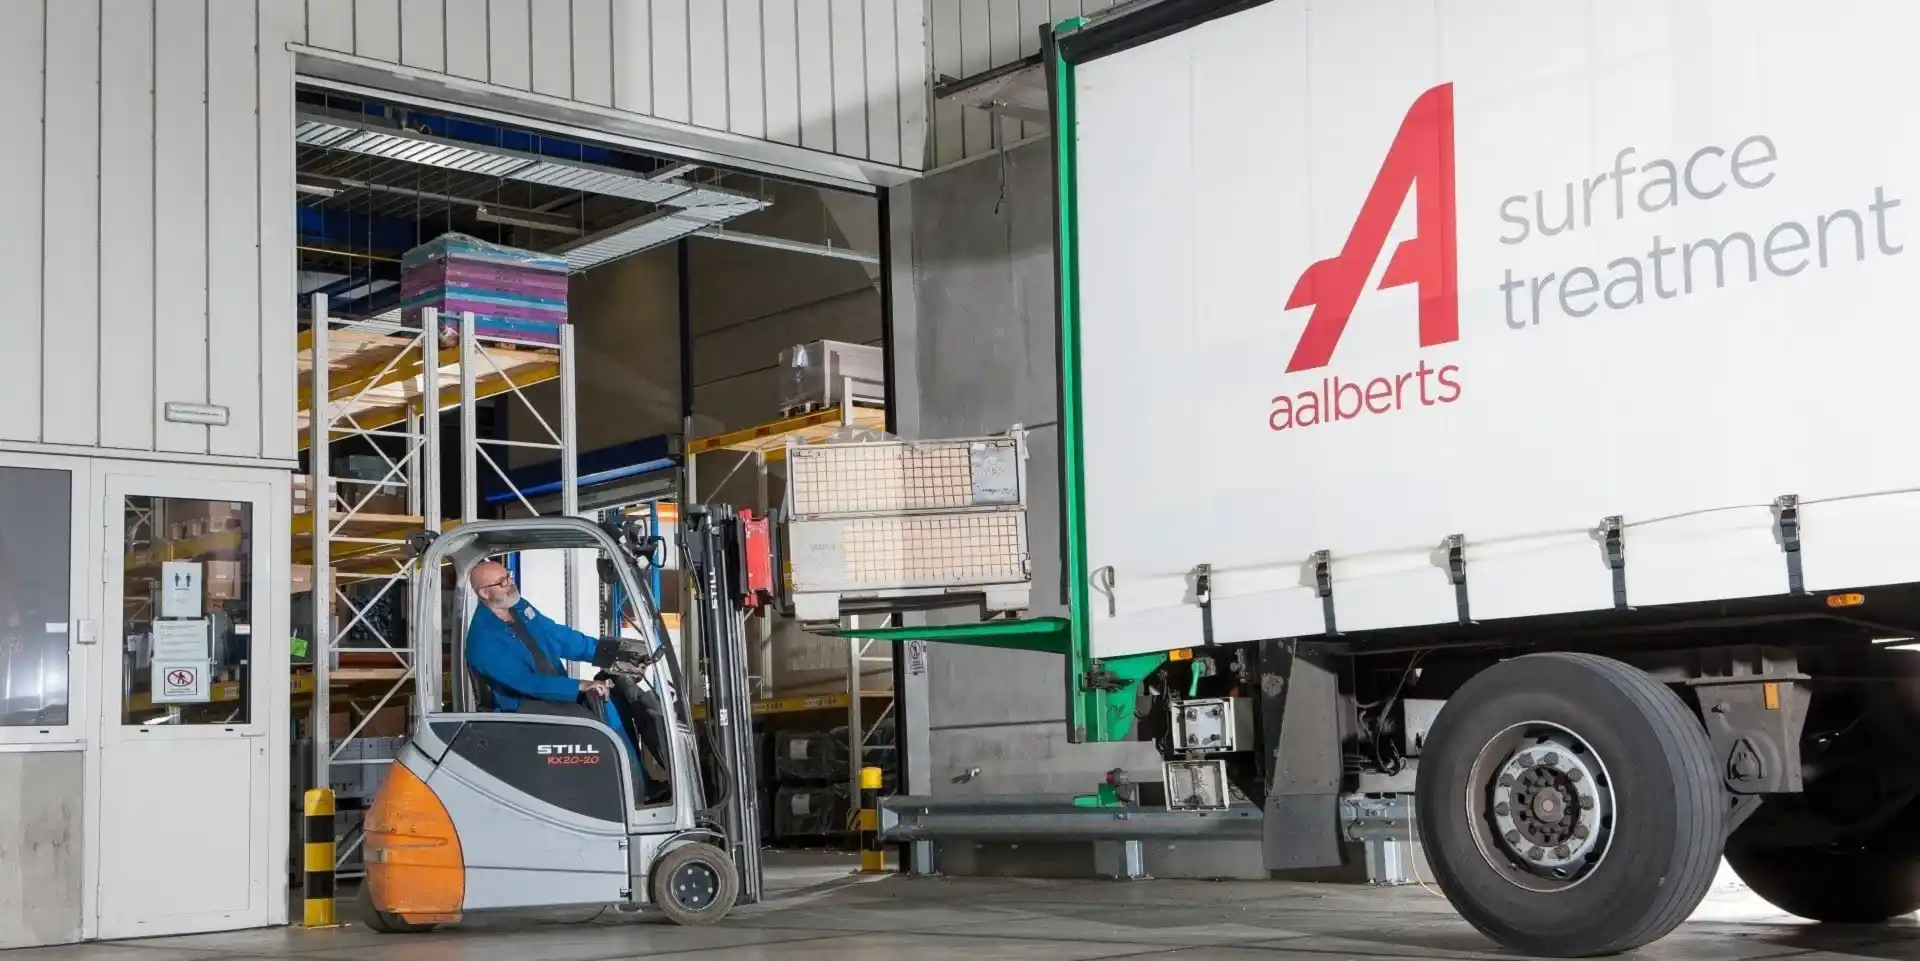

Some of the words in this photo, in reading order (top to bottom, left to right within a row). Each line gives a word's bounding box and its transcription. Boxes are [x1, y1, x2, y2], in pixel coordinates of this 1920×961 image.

[1499, 134, 1778, 247] surface
[1499, 186, 1905, 331] treatment
[1269, 360, 1461, 432] aalberts
[708, 567, 719, 607] STILL
[537, 744, 600, 755] STILL
